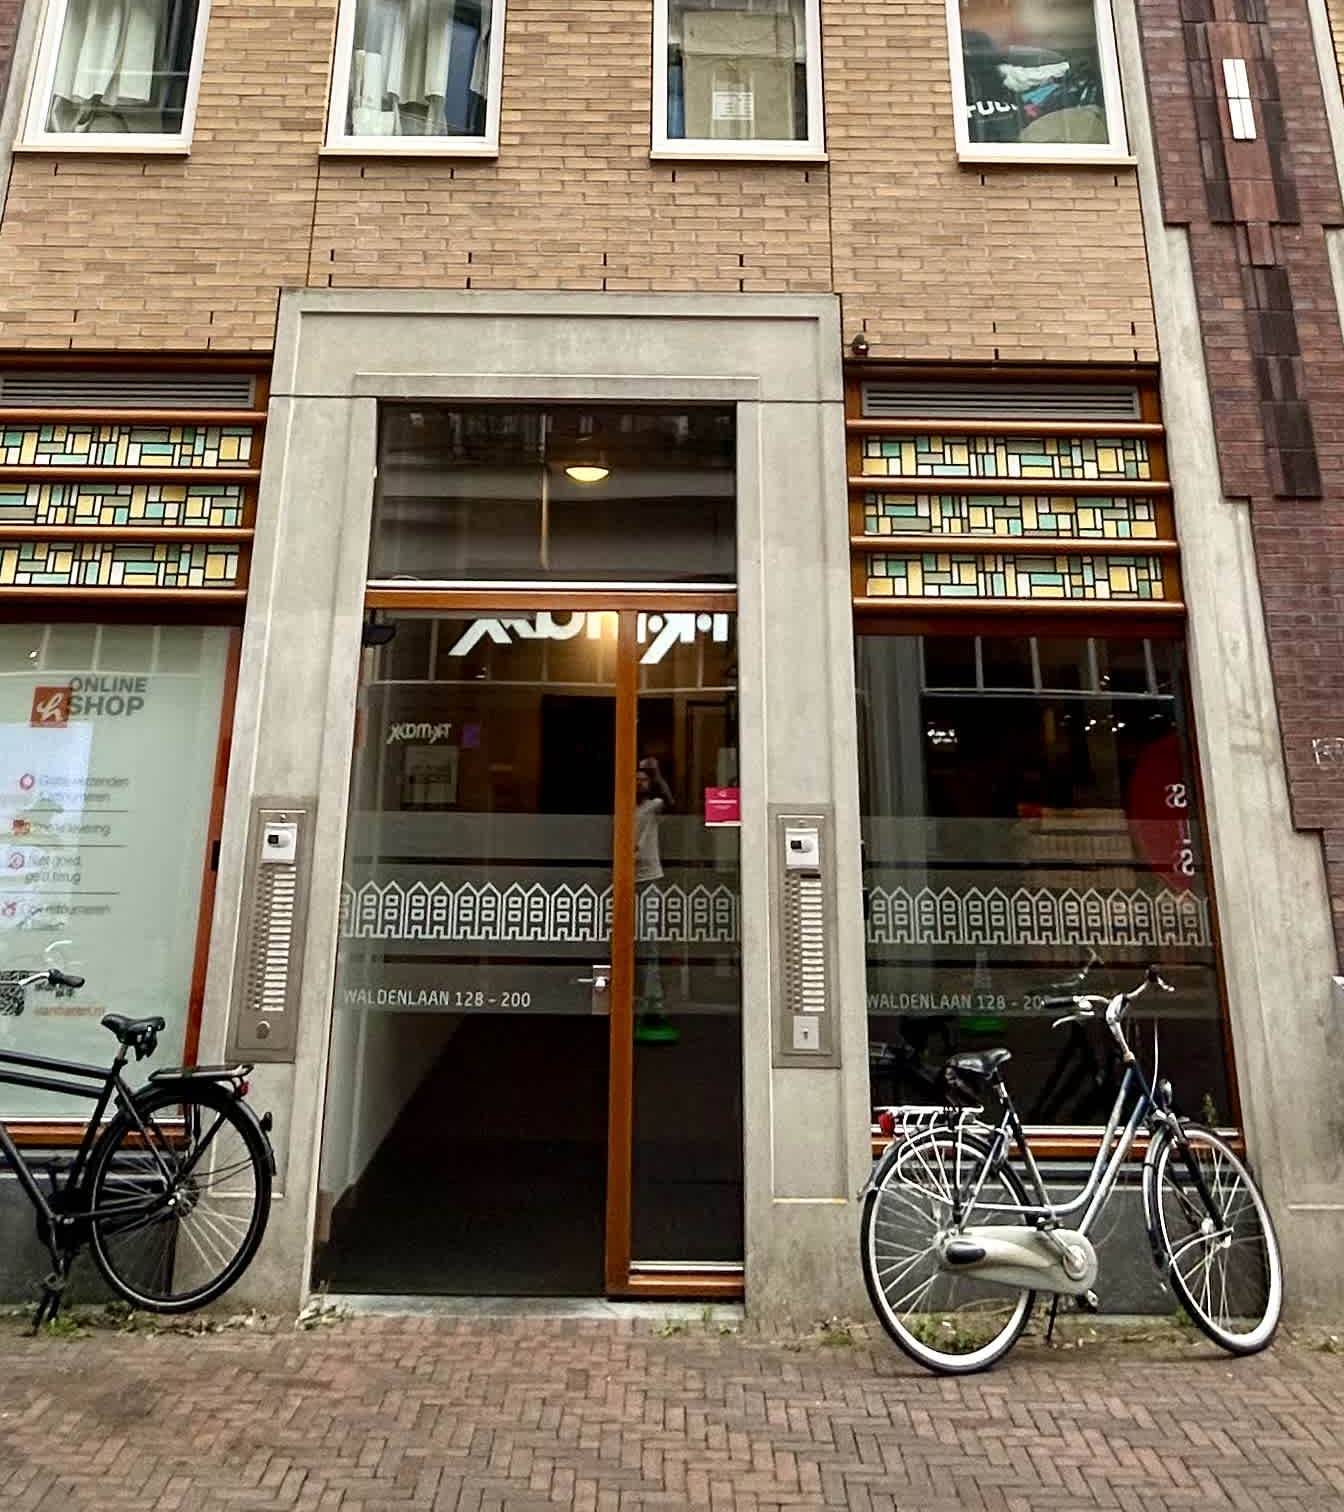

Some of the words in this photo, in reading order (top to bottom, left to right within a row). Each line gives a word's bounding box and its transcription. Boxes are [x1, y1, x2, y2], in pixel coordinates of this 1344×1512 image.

[69, 676, 148, 693] ONLINE
[68, 695, 145, 716] SHOP
[343, 989, 450, 1006] WALDENLAAN
[455, 991, 484, 1007] 128
[501, 992, 532, 1008] 200
[867, 993, 972, 1009] WALDENLAAN
[977, 994, 1006, 1009] 128
[1023, 995, 1046, 1009] 20
